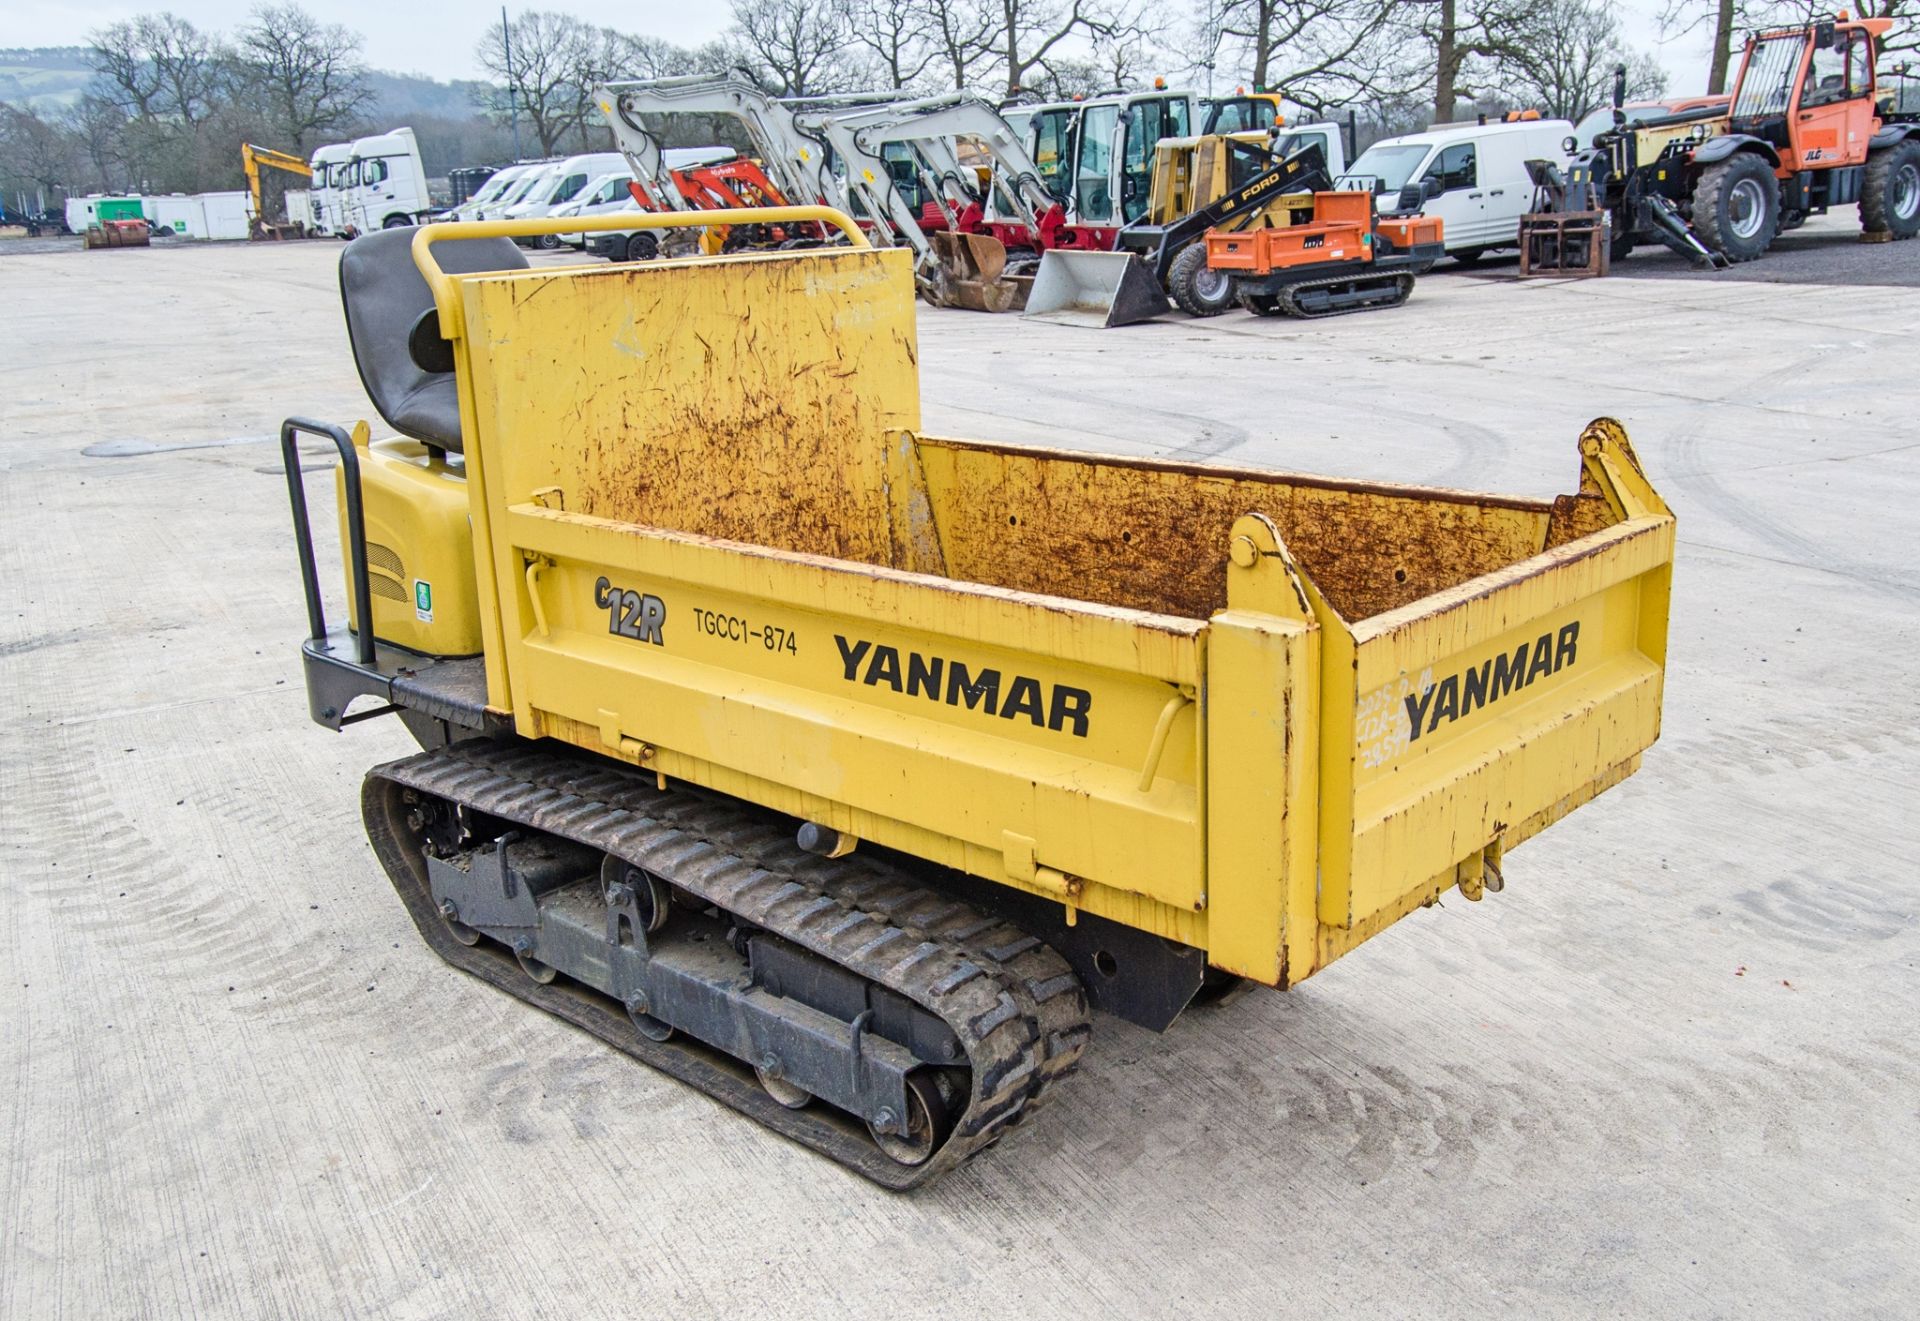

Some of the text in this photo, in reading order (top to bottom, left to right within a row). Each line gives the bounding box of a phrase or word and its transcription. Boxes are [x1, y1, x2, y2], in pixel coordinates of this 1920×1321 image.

[1805, 149, 1822, 161] JLG
[1241, 173, 1280, 201] FORD
[595, 576, 666, 646] C12R
[693, 608, 797, 656] TGCC1-874
[834, 634, 1092, 738] YANMAR
[1404, 621, 1580, 742] YANMAR
